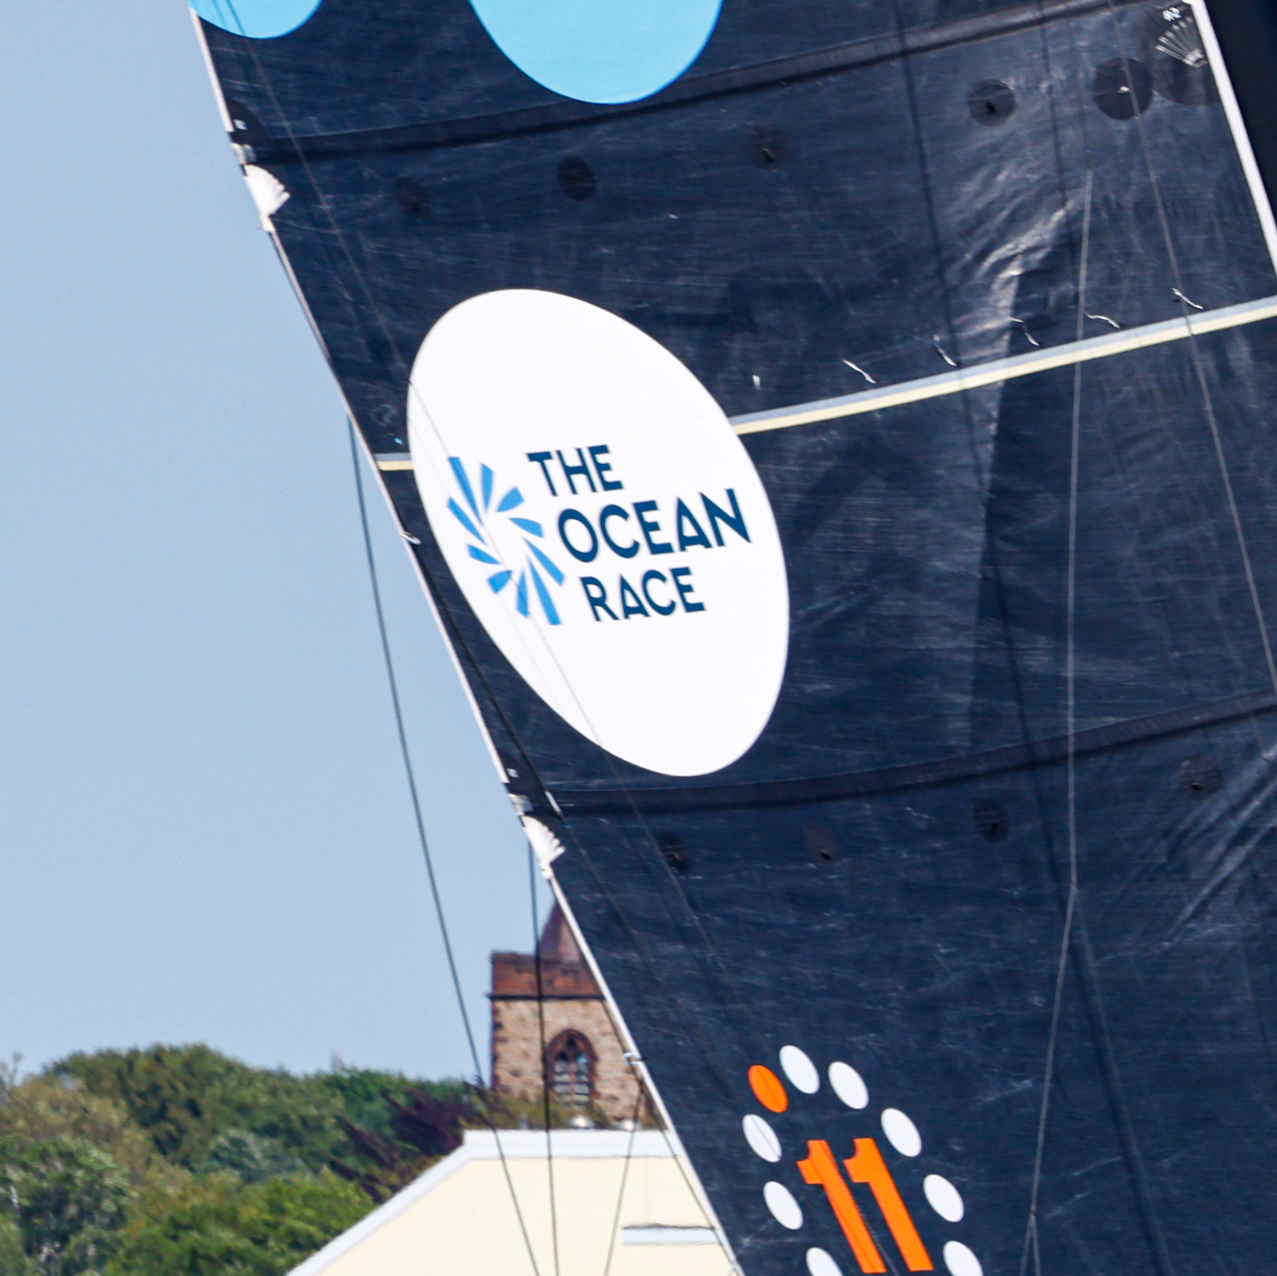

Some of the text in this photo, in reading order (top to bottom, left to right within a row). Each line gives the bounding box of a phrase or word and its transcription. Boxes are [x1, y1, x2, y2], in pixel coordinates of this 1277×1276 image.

[526, 444, 623, 497] THE
[557, 488, 752, 563] OCEAN
[579, 567, 706, 622] RACE
[797, 1138, 934, 1274] 11
